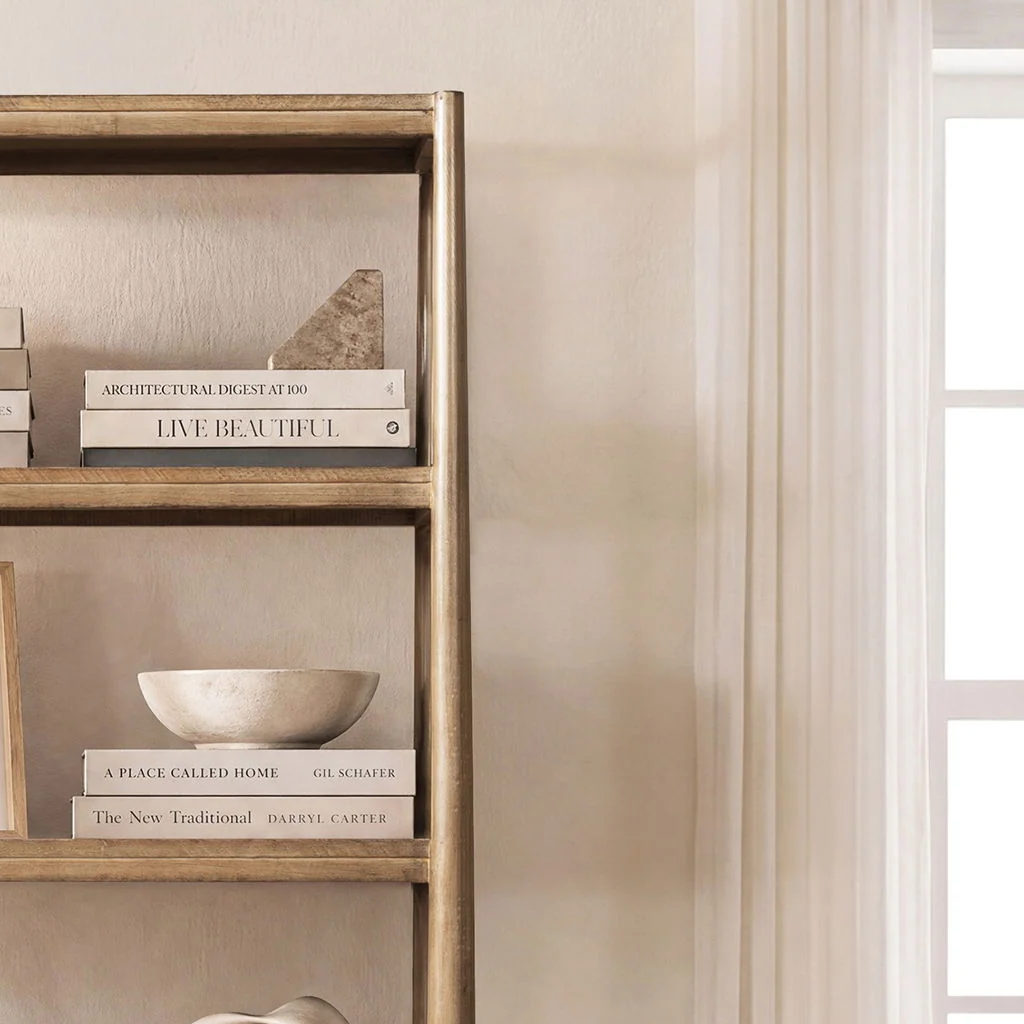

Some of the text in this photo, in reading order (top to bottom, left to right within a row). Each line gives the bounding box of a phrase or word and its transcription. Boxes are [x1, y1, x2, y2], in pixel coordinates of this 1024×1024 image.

[101, 383, 308, 396] ARCHITECTURAL DIGEST AT 100
[157, 418, 340, 438] LIVE BEAUTIFUL
[103, 767, 396, 779] A PLACE CALLED HOME GIL SCHAFER
[92, 810, 387, 825] The New Traditional DARRYL CARTER
